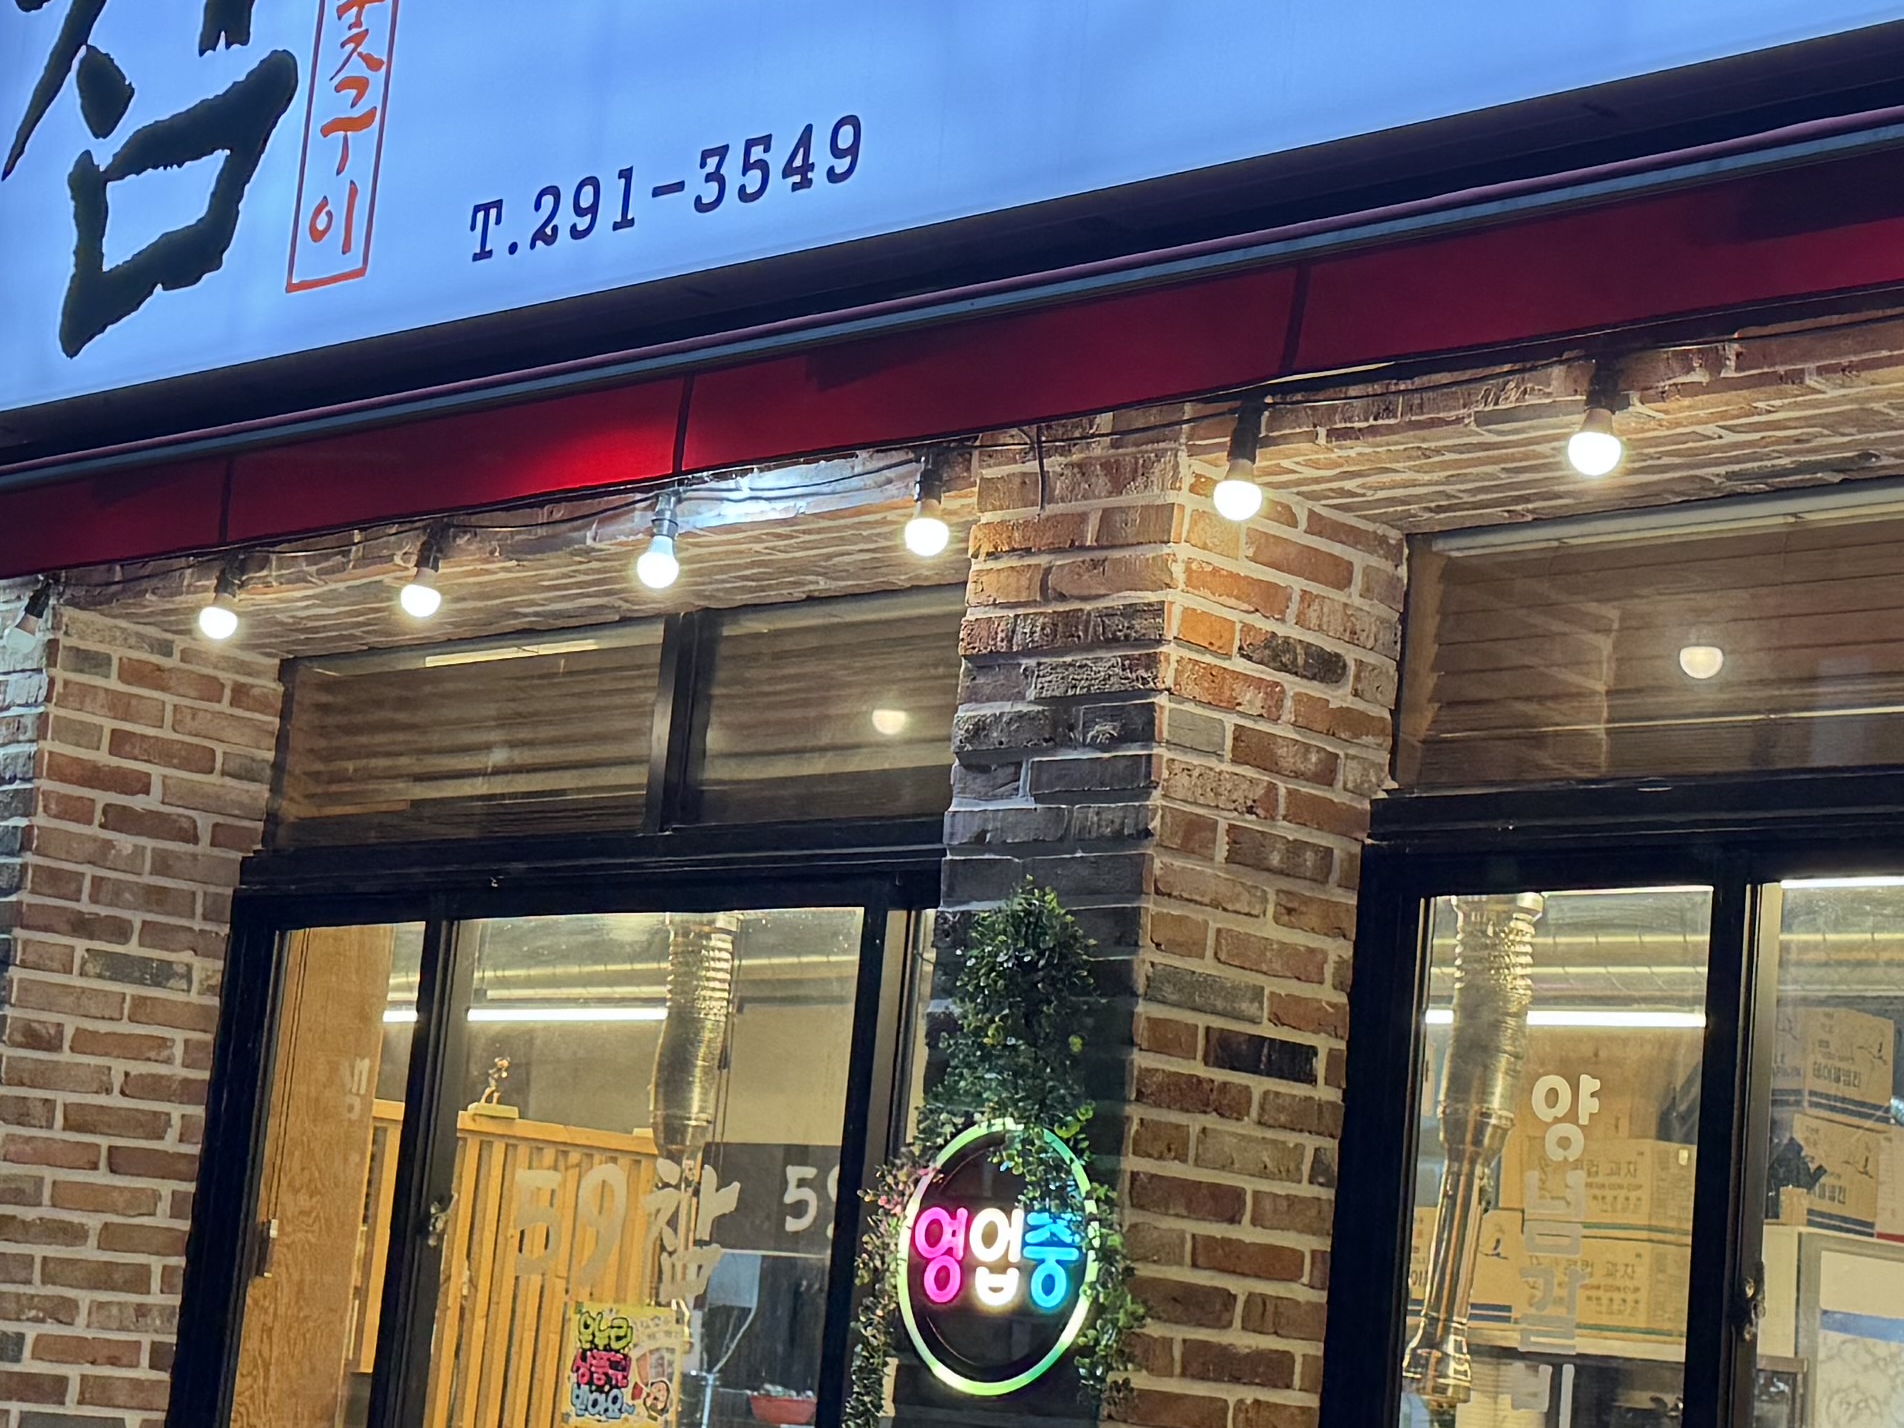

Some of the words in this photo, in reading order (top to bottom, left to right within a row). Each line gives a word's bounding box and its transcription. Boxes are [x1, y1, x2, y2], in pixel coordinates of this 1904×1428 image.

[469, 114, 864, 263] T.291-3549
[514, 1157, 742, 1303] 59참
[914, 1206, 1081, 1310] 영업중
[571, 1348, 633, 1389] 상품권
[579, 1310, 634, 1350] 온누리
